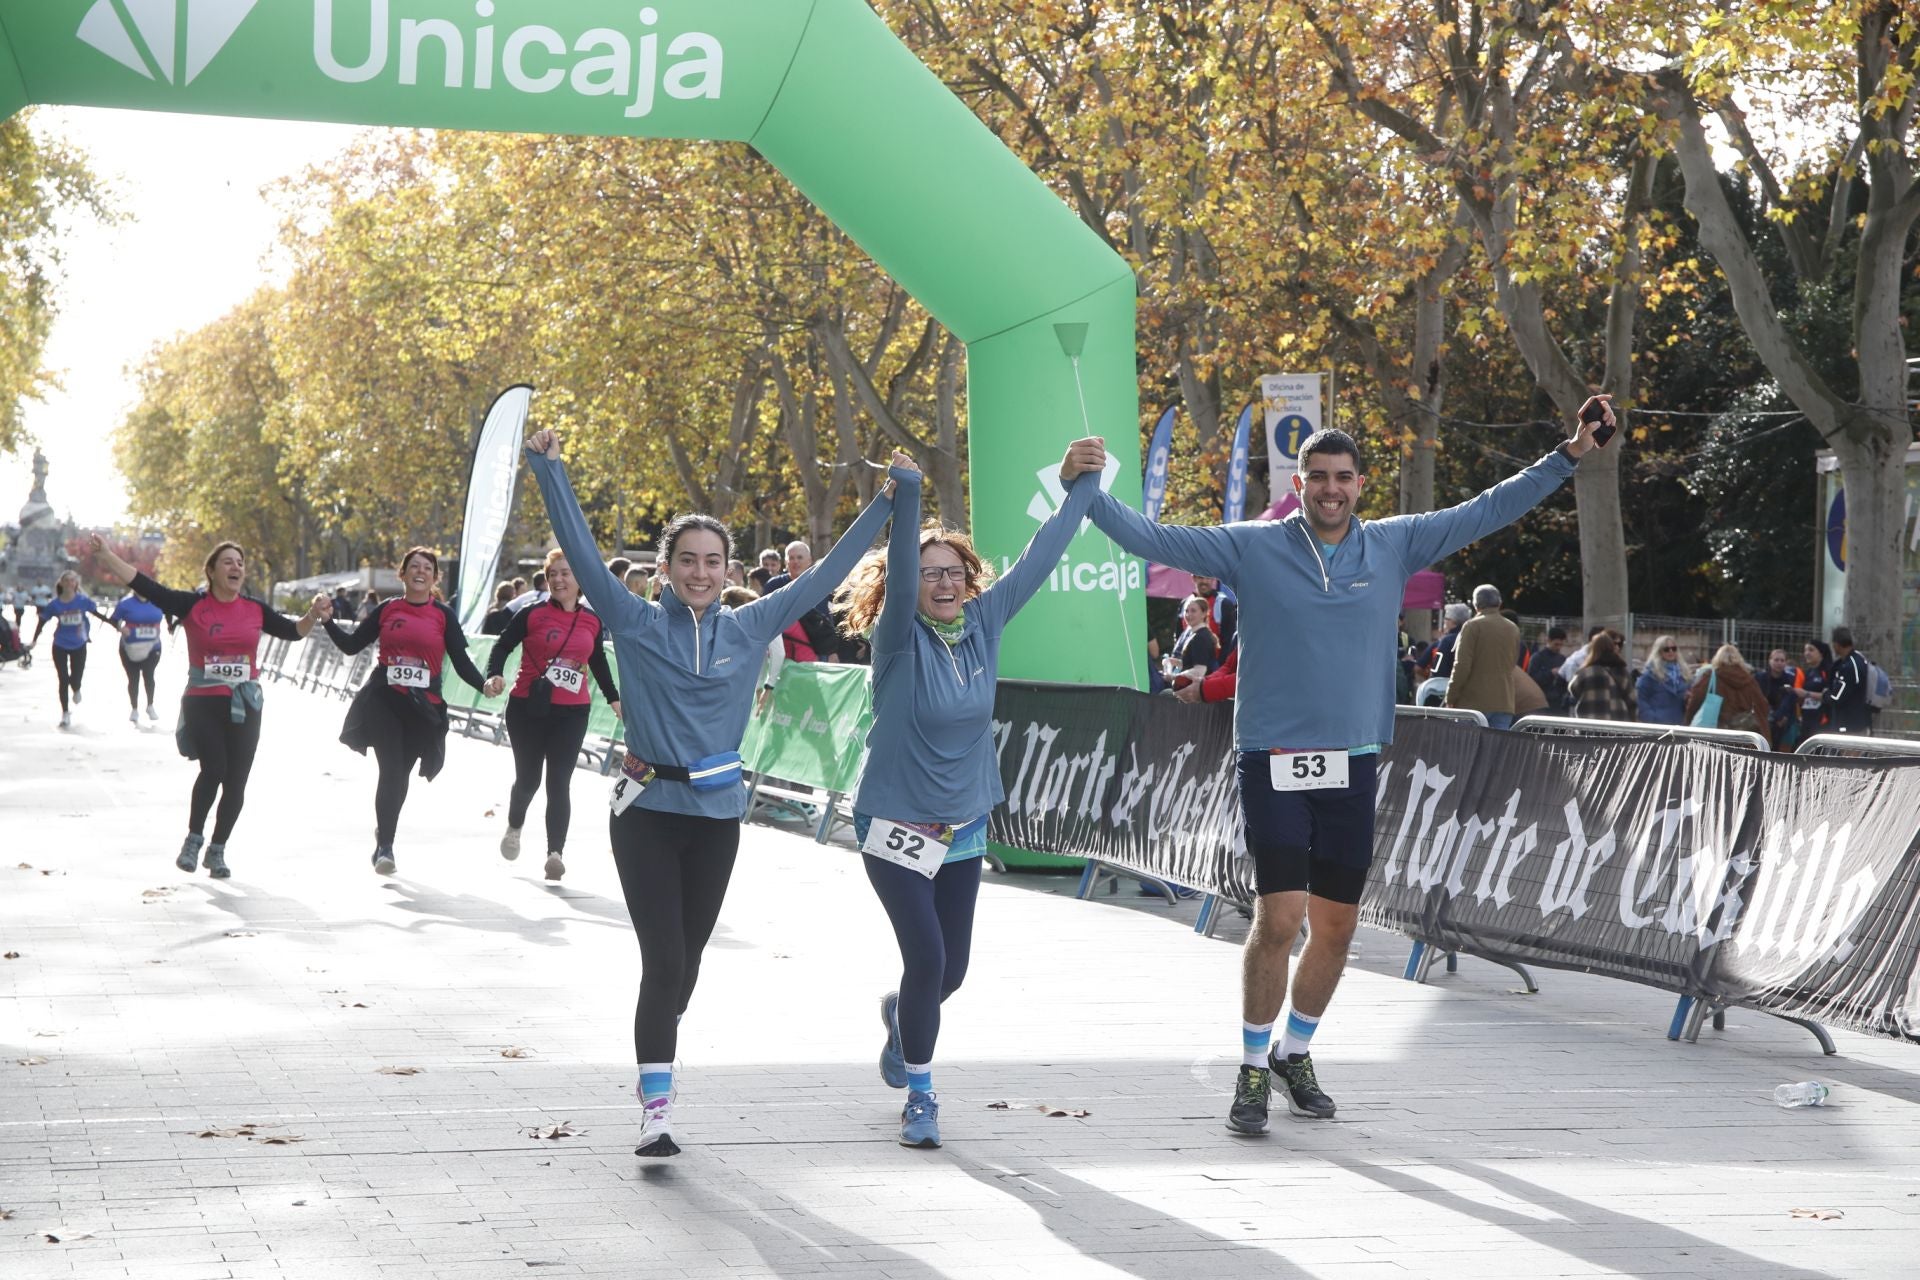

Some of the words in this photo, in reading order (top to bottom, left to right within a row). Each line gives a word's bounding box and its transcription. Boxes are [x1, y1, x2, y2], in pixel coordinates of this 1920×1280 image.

[314, 0, 723, 118] Unicaja
[1269, 383, 1294, 391] Oficina
[1003, 552, 1140, 601] icaja
[211, 665, 243, 678] 395
[393, 667, 423, 681] 394
[553, 668, 578, 686] 396
[1292, 754, 1327, 779] 53
[886, 826, 926, 861] 52
[1385, 758, 1538, 911] Norte
[1537, 797, 1616, 921] de
[1619, 796, 1878, 964] Castilla
